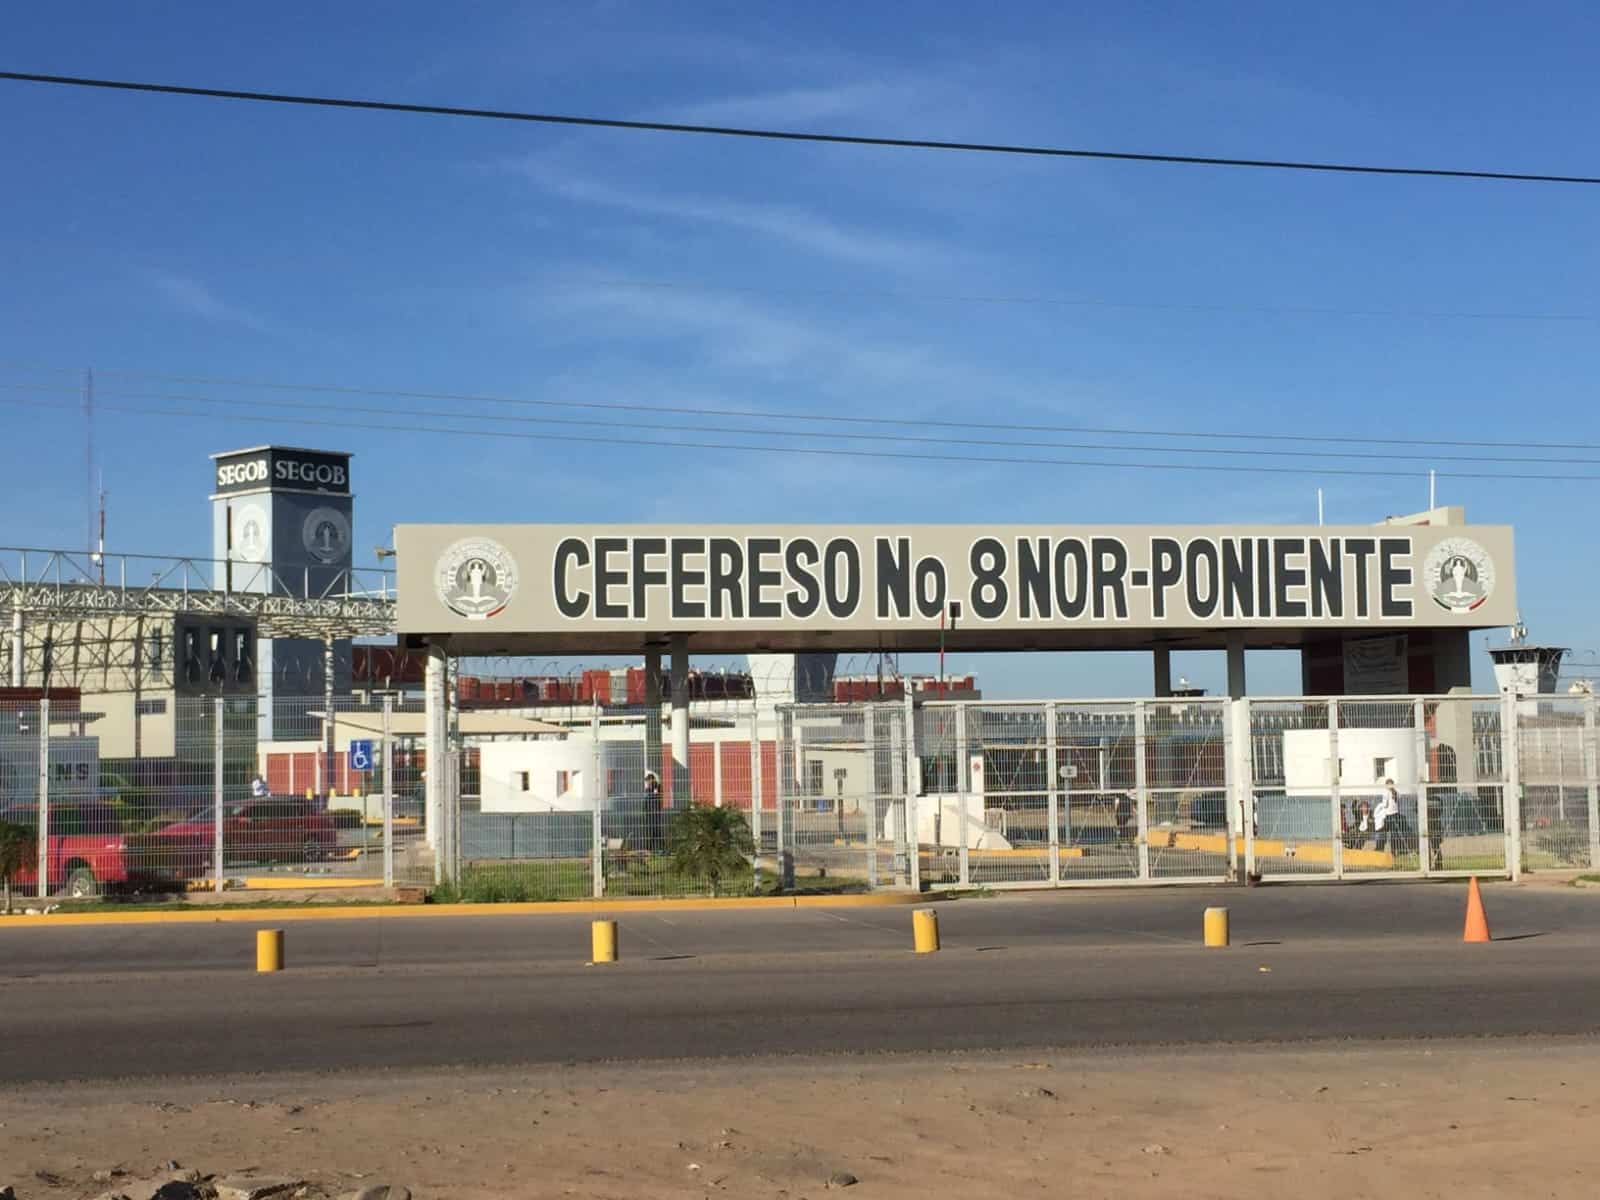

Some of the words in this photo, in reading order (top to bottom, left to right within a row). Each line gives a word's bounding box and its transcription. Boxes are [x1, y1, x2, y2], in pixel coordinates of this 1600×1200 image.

[218, 459, 268, 486] SEGOB
[275, 459, 345, 485] SEGOB
[553, 536, 862, 619] CEFERESO
[874, 536, 962, 620] No.
[968, 536, 1008, 619] 8
[1015, 536, 1416, 619] NOR-PONIENTE
